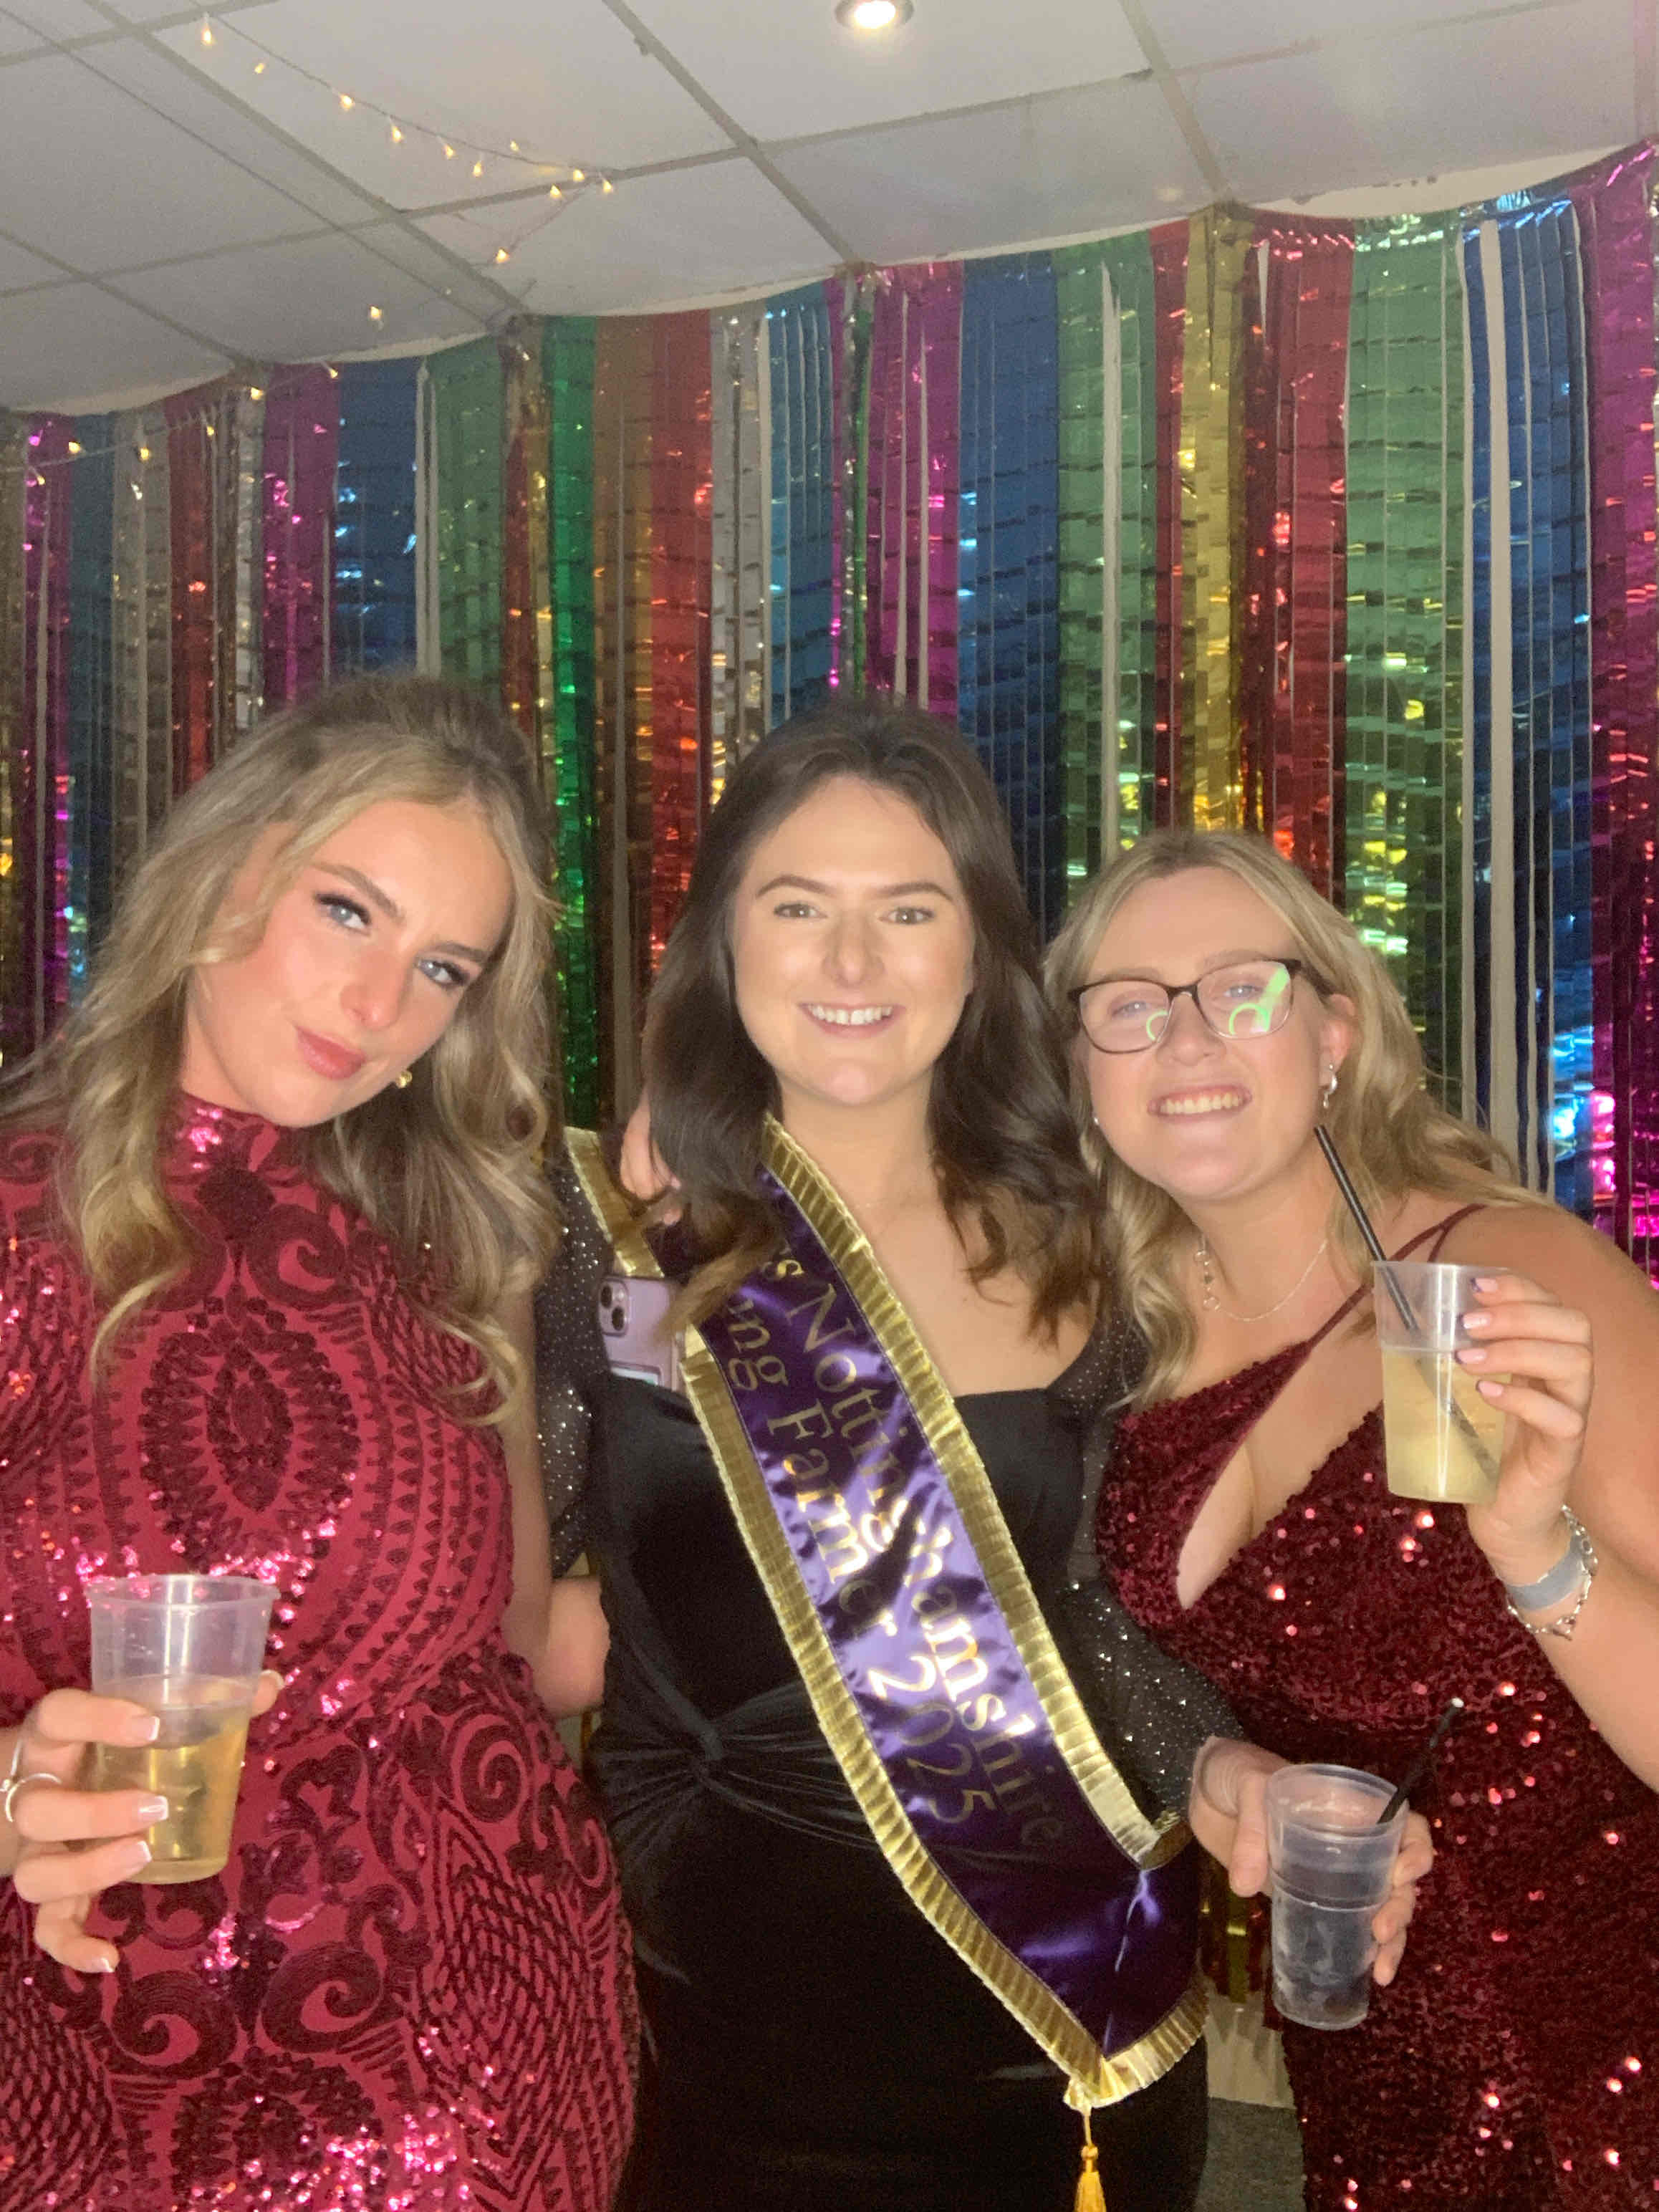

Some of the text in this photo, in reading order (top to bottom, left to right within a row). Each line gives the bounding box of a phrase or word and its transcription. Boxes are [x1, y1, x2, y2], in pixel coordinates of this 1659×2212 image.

[767, 1398, 898, 1638] Farmer
[867, 1654, 999, 1824] 2025
[787, 1282, 1064, 1846] Nottinghamshire
